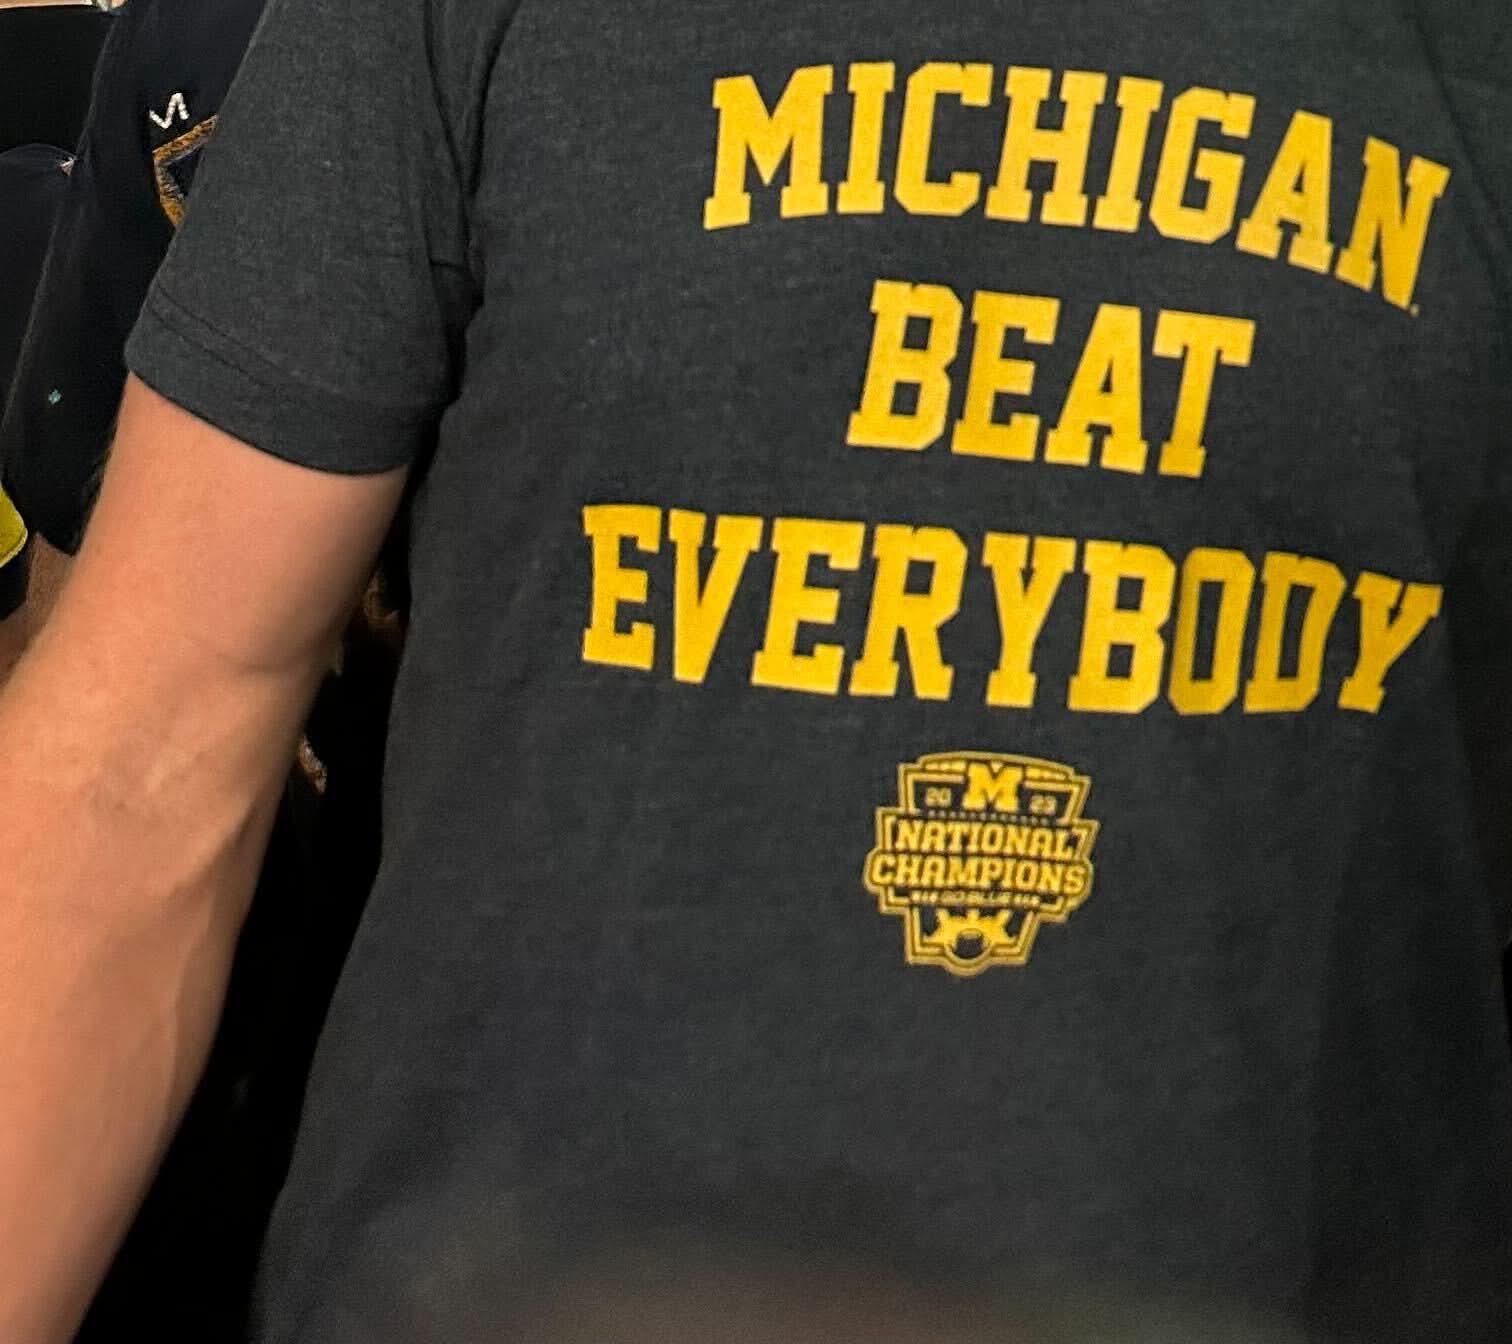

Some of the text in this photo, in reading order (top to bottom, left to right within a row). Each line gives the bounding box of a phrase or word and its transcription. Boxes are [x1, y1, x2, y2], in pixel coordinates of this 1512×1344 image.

[703, 62, 1450, 311] MICHIGAN
[847, 279, 1256, 478] BEAT
[582, 503, 1443, 715] EVERYBODY
[896, 816, 1075, 861] NATIONAL
[962, 763, 1023, 812] M
[871, 854, 1086, 896] CHAMPIONS
